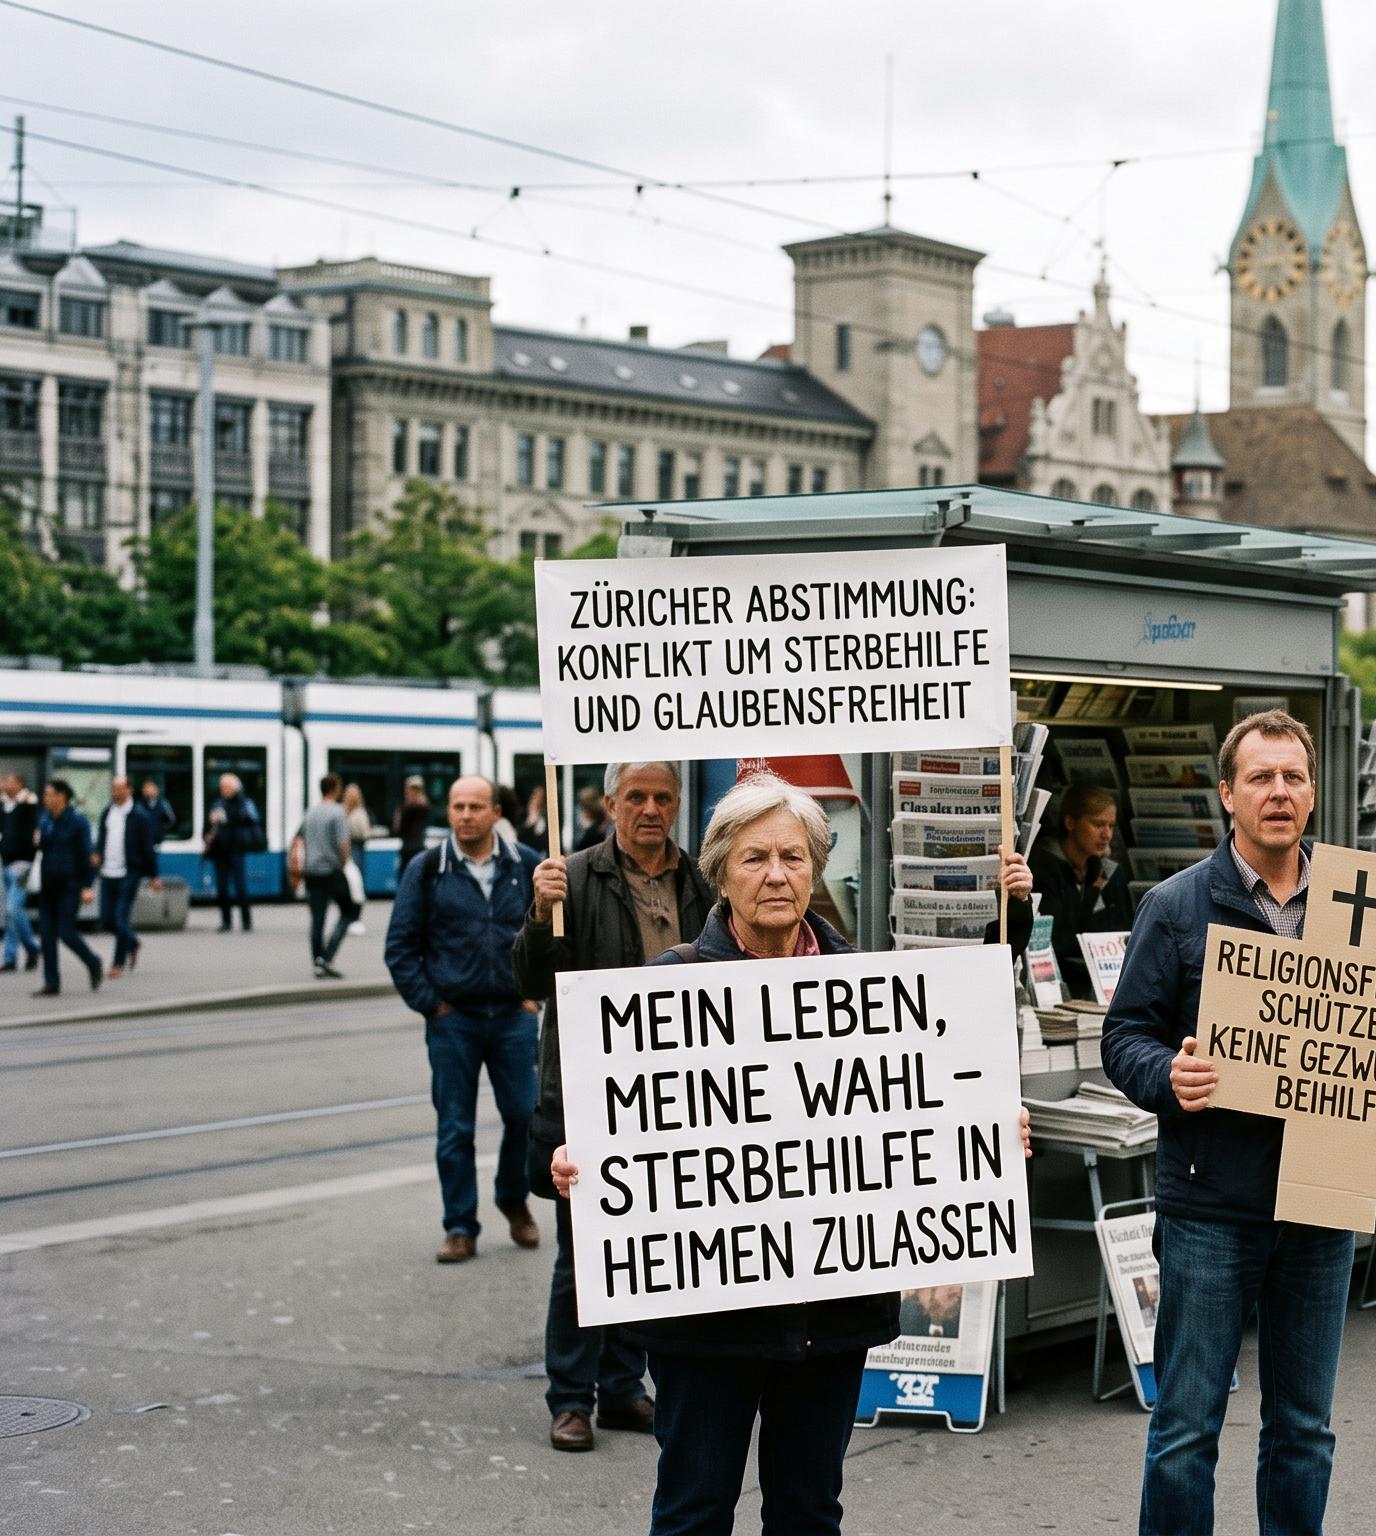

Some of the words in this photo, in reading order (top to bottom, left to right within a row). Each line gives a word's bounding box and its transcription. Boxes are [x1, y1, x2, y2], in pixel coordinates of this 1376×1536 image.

[570, 580, 733, 630] ZÜRICHER
[745, 577, 976, 623] ABSTIMMUNG:
[558, 640, 713, 682] KONFLIKT
[725, 638, 772, 675] UM
[784, 629, 990, 673] STERBEHILFE
[574, 692, 641, 734] UND
[654, 681, 972, 731] GLAUBENSFREIHEIT
[600, 986, 735, 1055] MEIN
[760, 973, 946, 1043] LEBEN,
[1209, 1022, 1288, 1069] KEINE
[605, 1063, 772, 1136] MEINE
[793, 1052, 944, 1119] WAHL
[599, 1128, 937, 1217] STERBEHILFE
[957, 1122, 1002, 1182] IN
[603, 1221, 794, 1298] HEIMEN
[812, 1198, 1017, 1276] ZULASSEN
